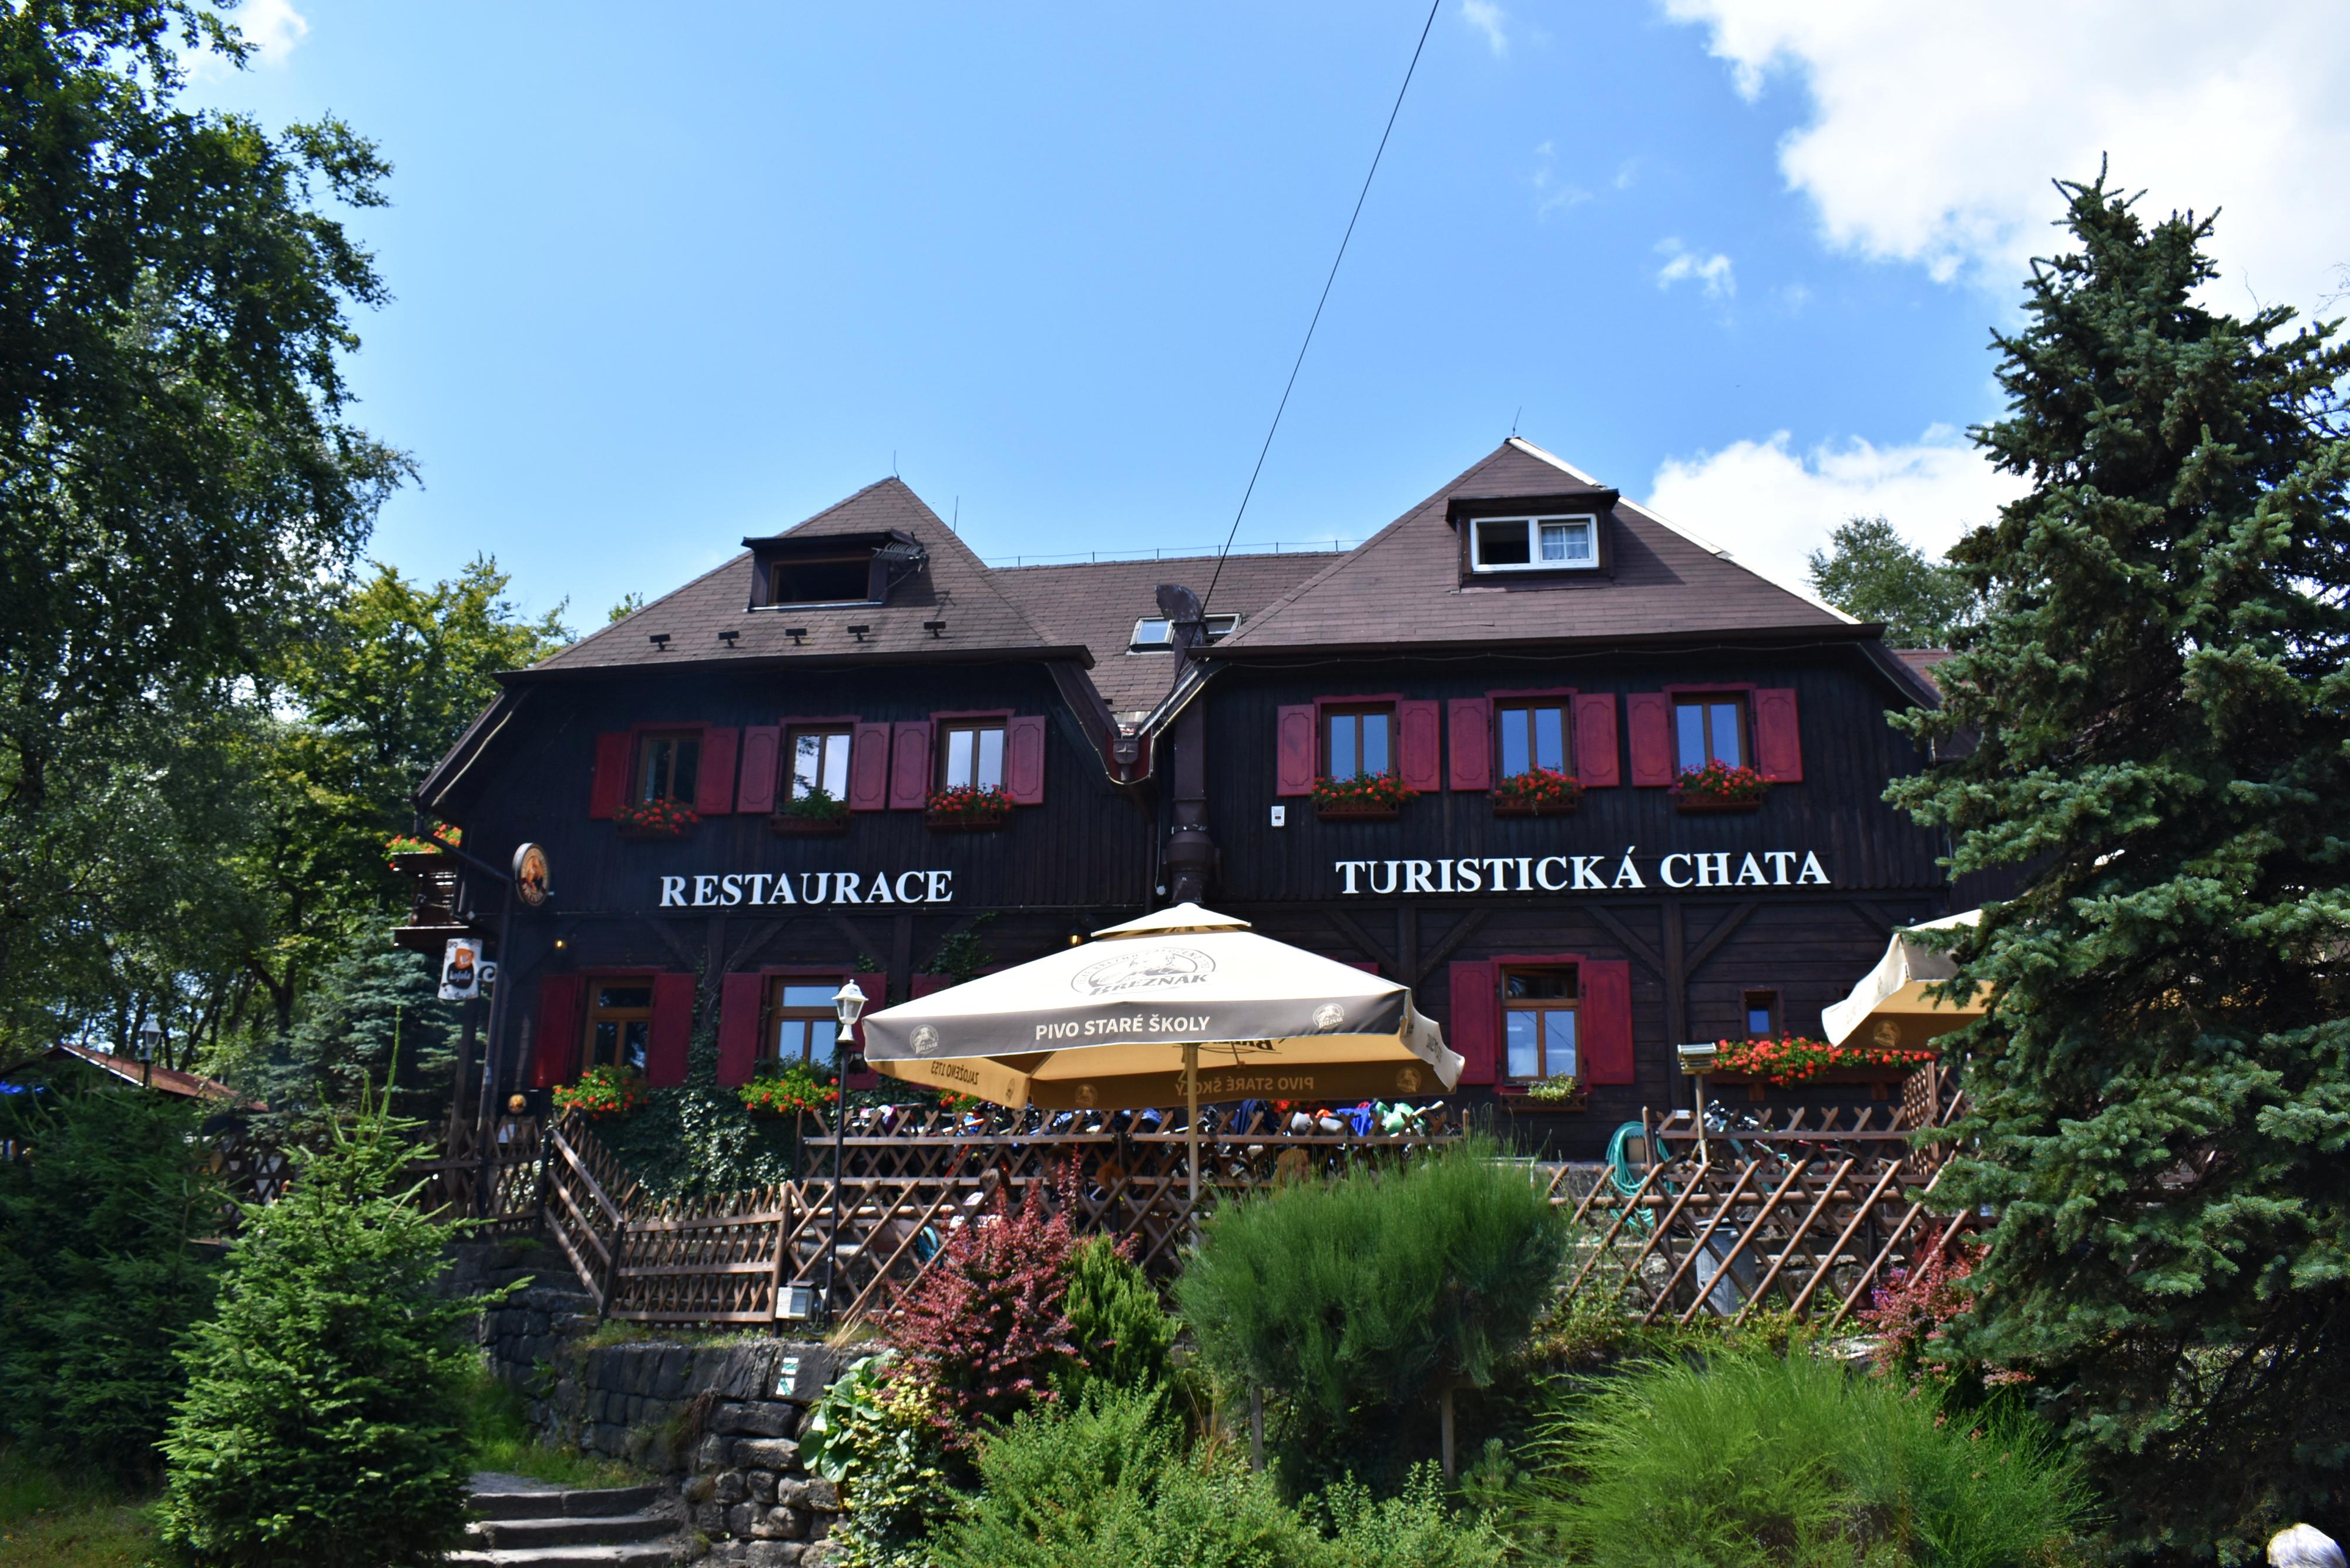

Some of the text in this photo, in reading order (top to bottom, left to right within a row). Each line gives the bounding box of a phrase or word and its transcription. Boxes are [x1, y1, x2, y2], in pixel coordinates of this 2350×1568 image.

[1335, 846, 1831, 894] TURISTICKÁ CHATA
[659, 871, 953, 906] RESTAURACE
[1036, 1014, 1210, 1040] PIVO STARÉ ŠKOLY
